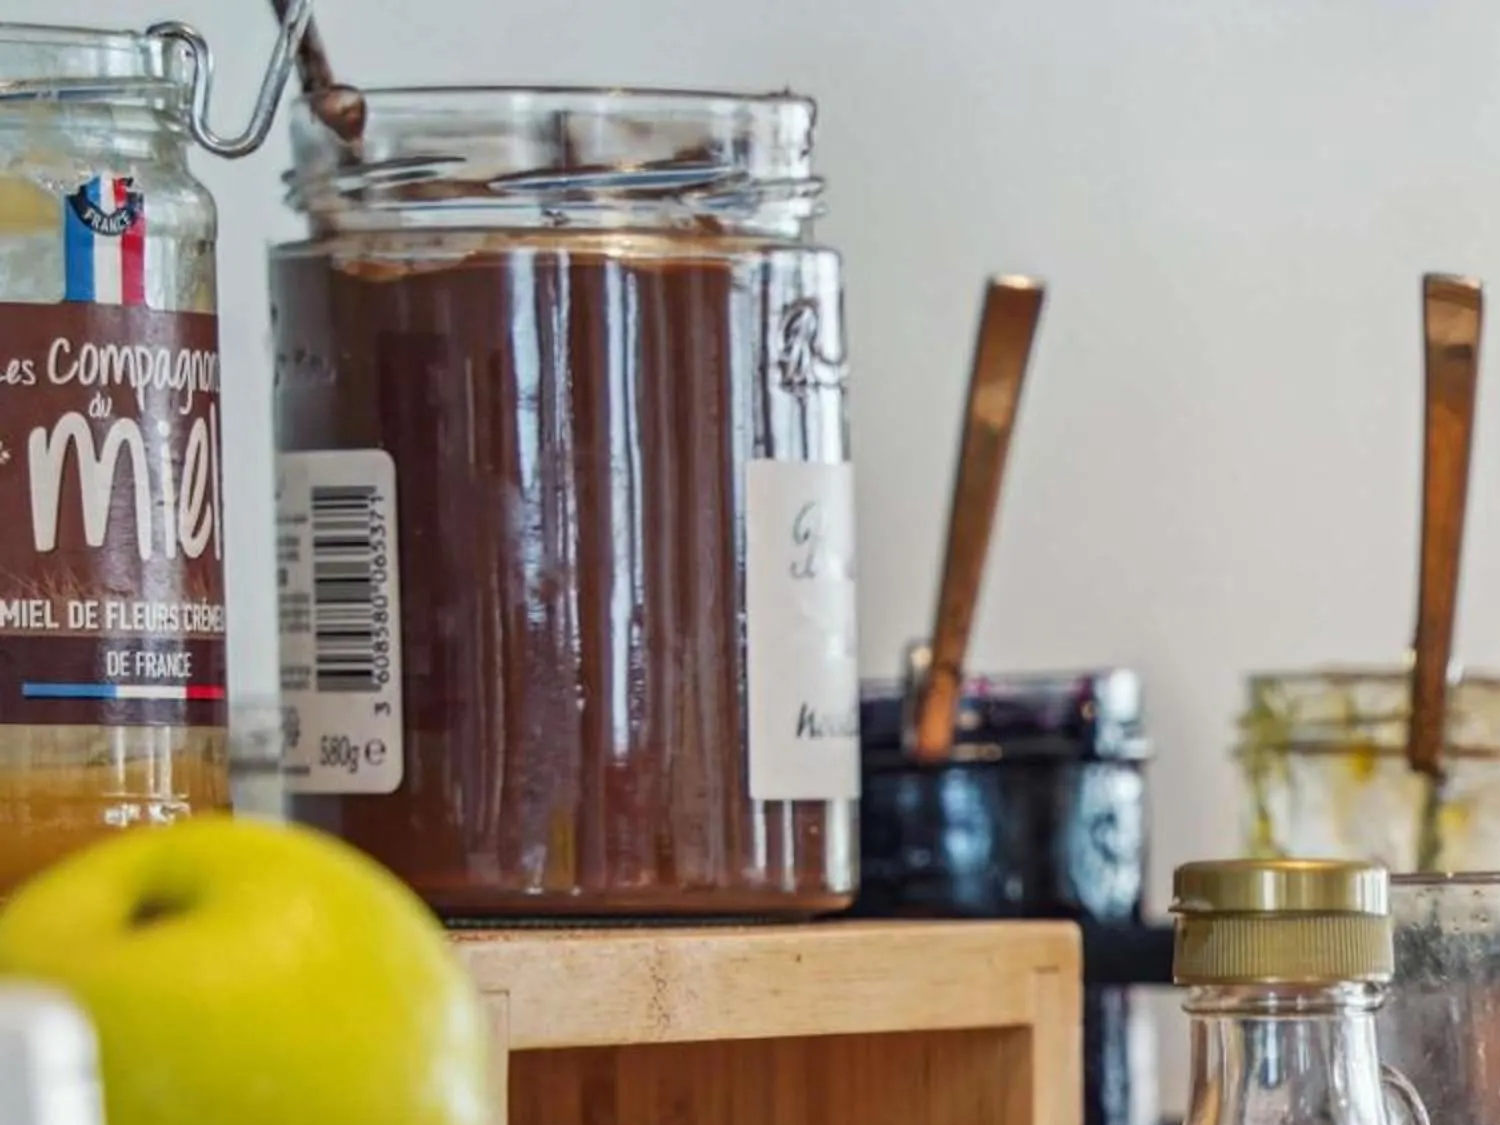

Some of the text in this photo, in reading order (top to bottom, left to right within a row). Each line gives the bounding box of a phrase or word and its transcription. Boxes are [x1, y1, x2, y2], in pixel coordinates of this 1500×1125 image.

[0, 358, 36, 386] es
[88, 394, 113, 418] du
[0, 598, 60, 629] MIEL
[67, 600, 99, 630] DE
[105, 602, 179, 633] FLEURS
[106, 651, 192, 679] DE FRANCE
